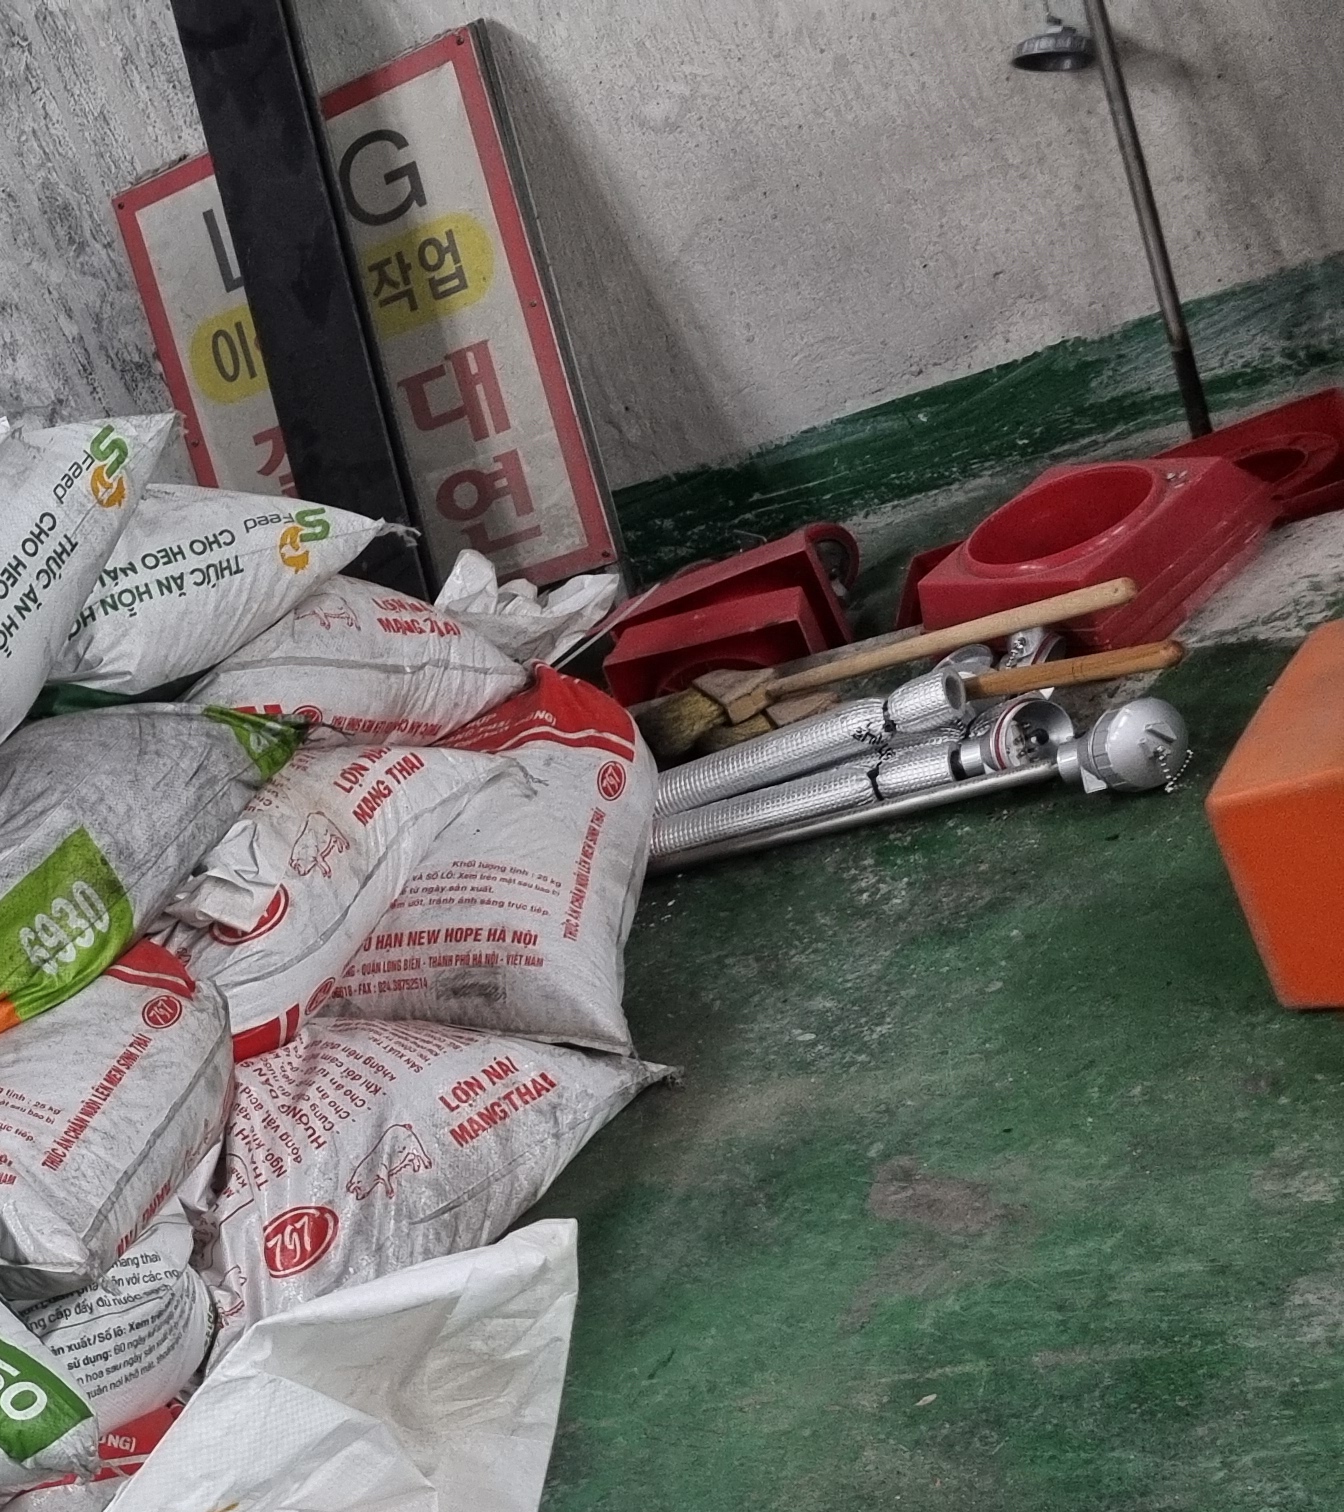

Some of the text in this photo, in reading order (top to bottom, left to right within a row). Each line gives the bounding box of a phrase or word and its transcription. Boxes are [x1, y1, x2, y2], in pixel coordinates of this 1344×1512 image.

[367, 229, 468, 313] 작업
[17, 508, 61, 560] CHO
[139, 526, 237, 571] CHO HEO
[31, 531, 82, 593] THỨC
[10, 583, 47, 623] ĂN
[384, 746, 426, 789] THAI
[375, 926, 537, 952] HẠN NEW HOPE HÀ NỘI
[436, 1050, 519, 1119] LỢN NÁI
[448, 1068, 557, 1148] MANG THAI
